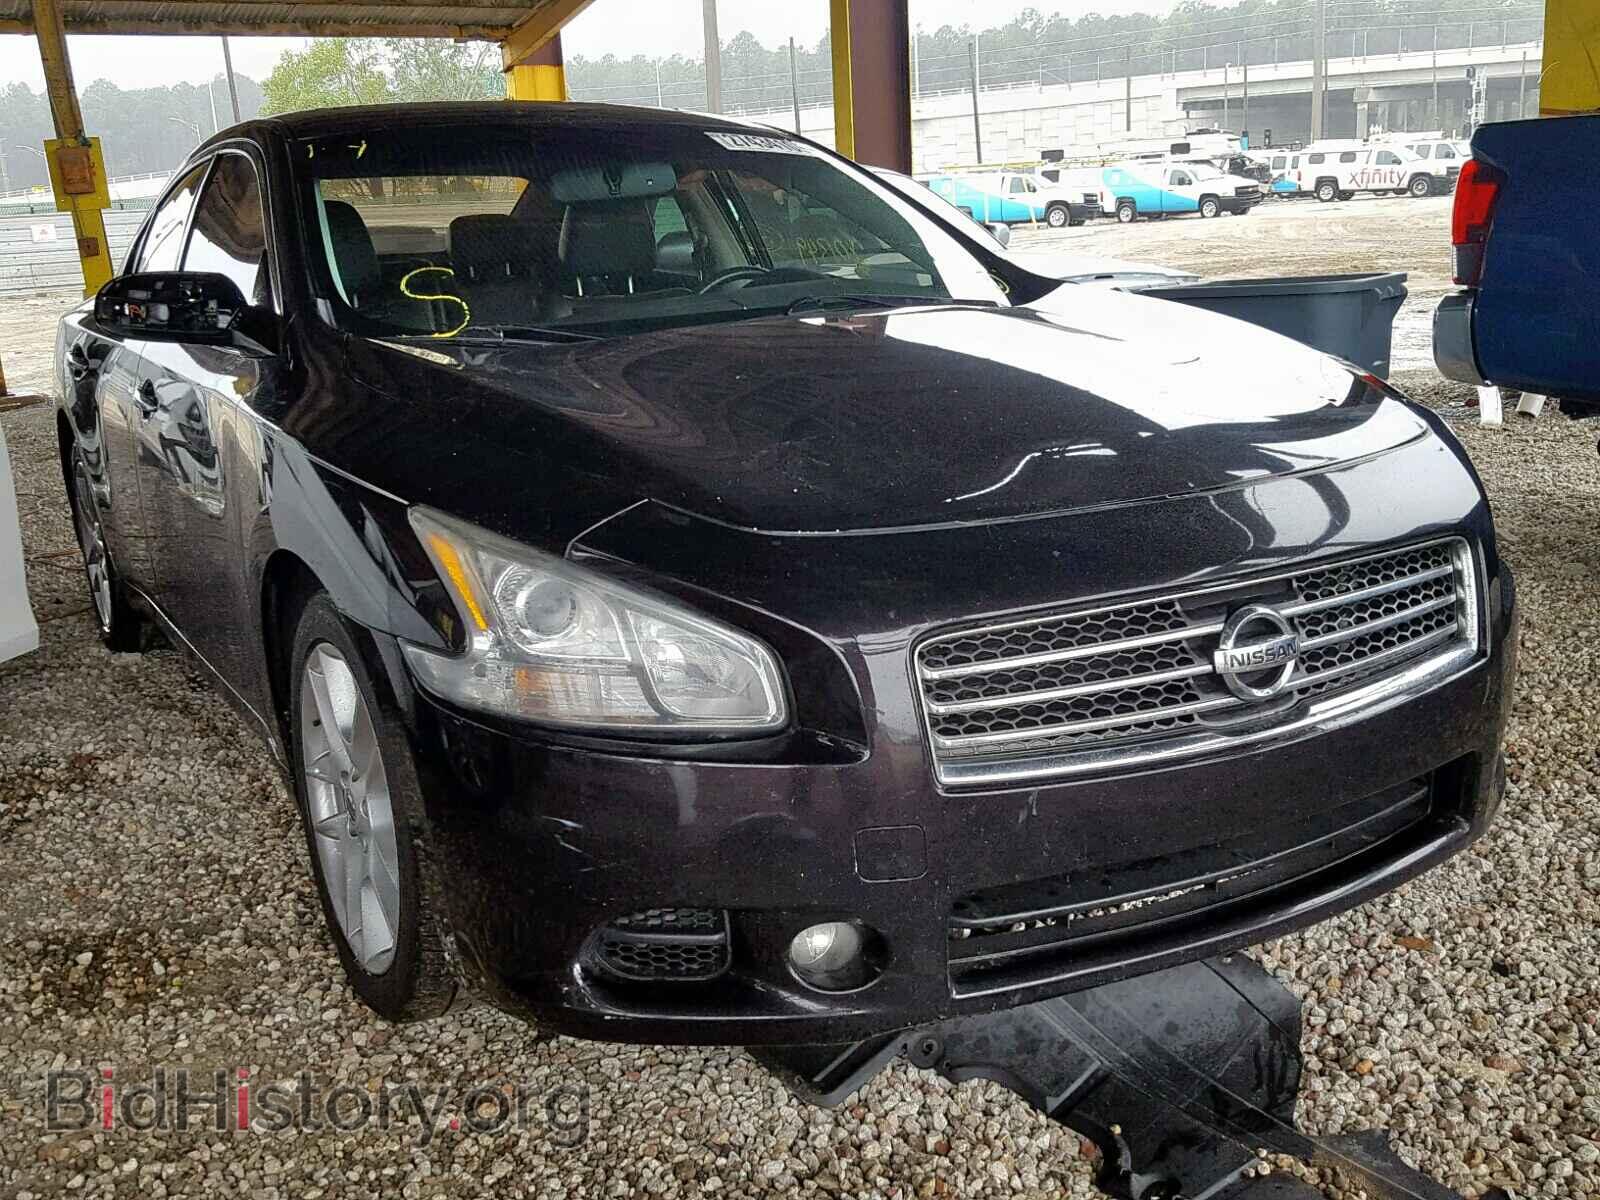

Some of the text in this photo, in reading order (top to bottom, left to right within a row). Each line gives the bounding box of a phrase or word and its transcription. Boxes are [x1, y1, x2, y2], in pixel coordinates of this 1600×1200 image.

[1350, 168, 1407, 187] xfinity
[400, 266, 471, 338] S
[1229, 639, 1297, 668] NISSAN
